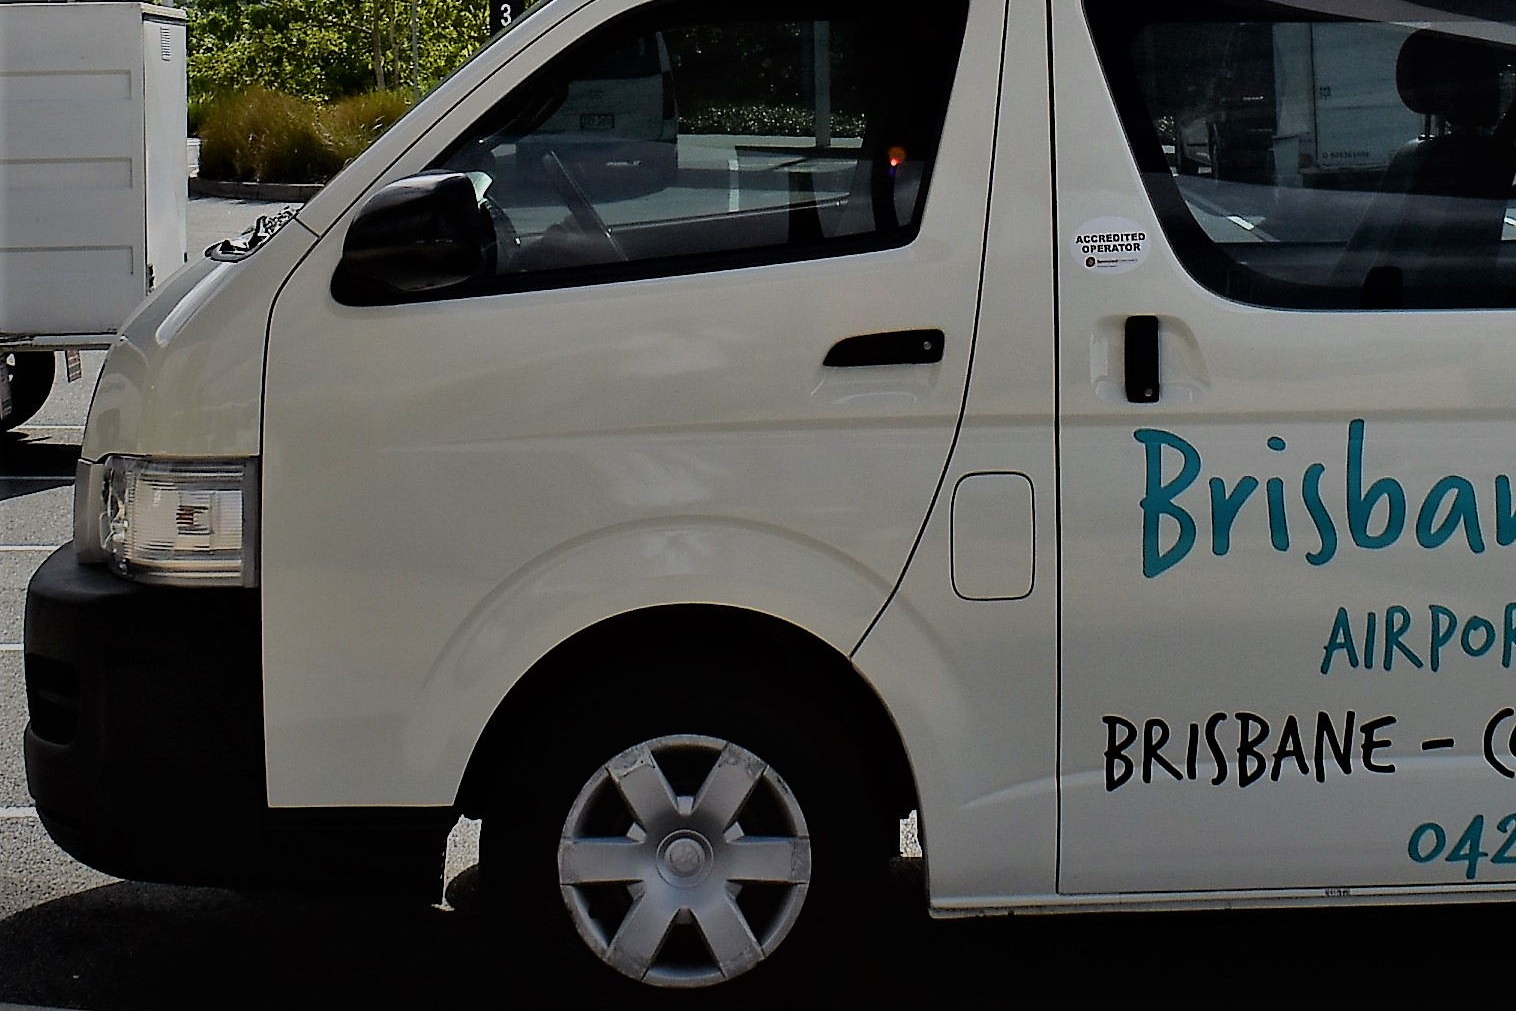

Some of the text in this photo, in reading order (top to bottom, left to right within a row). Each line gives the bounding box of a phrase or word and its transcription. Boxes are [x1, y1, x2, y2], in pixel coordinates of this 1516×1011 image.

[500, 3, 512, 27] 3
[1075, 232, 1146, 244] ACCREDITED
[1081, 242, 1141, 254] OPERATOR
[1101, 710, 1398, 792] BRISBANE
